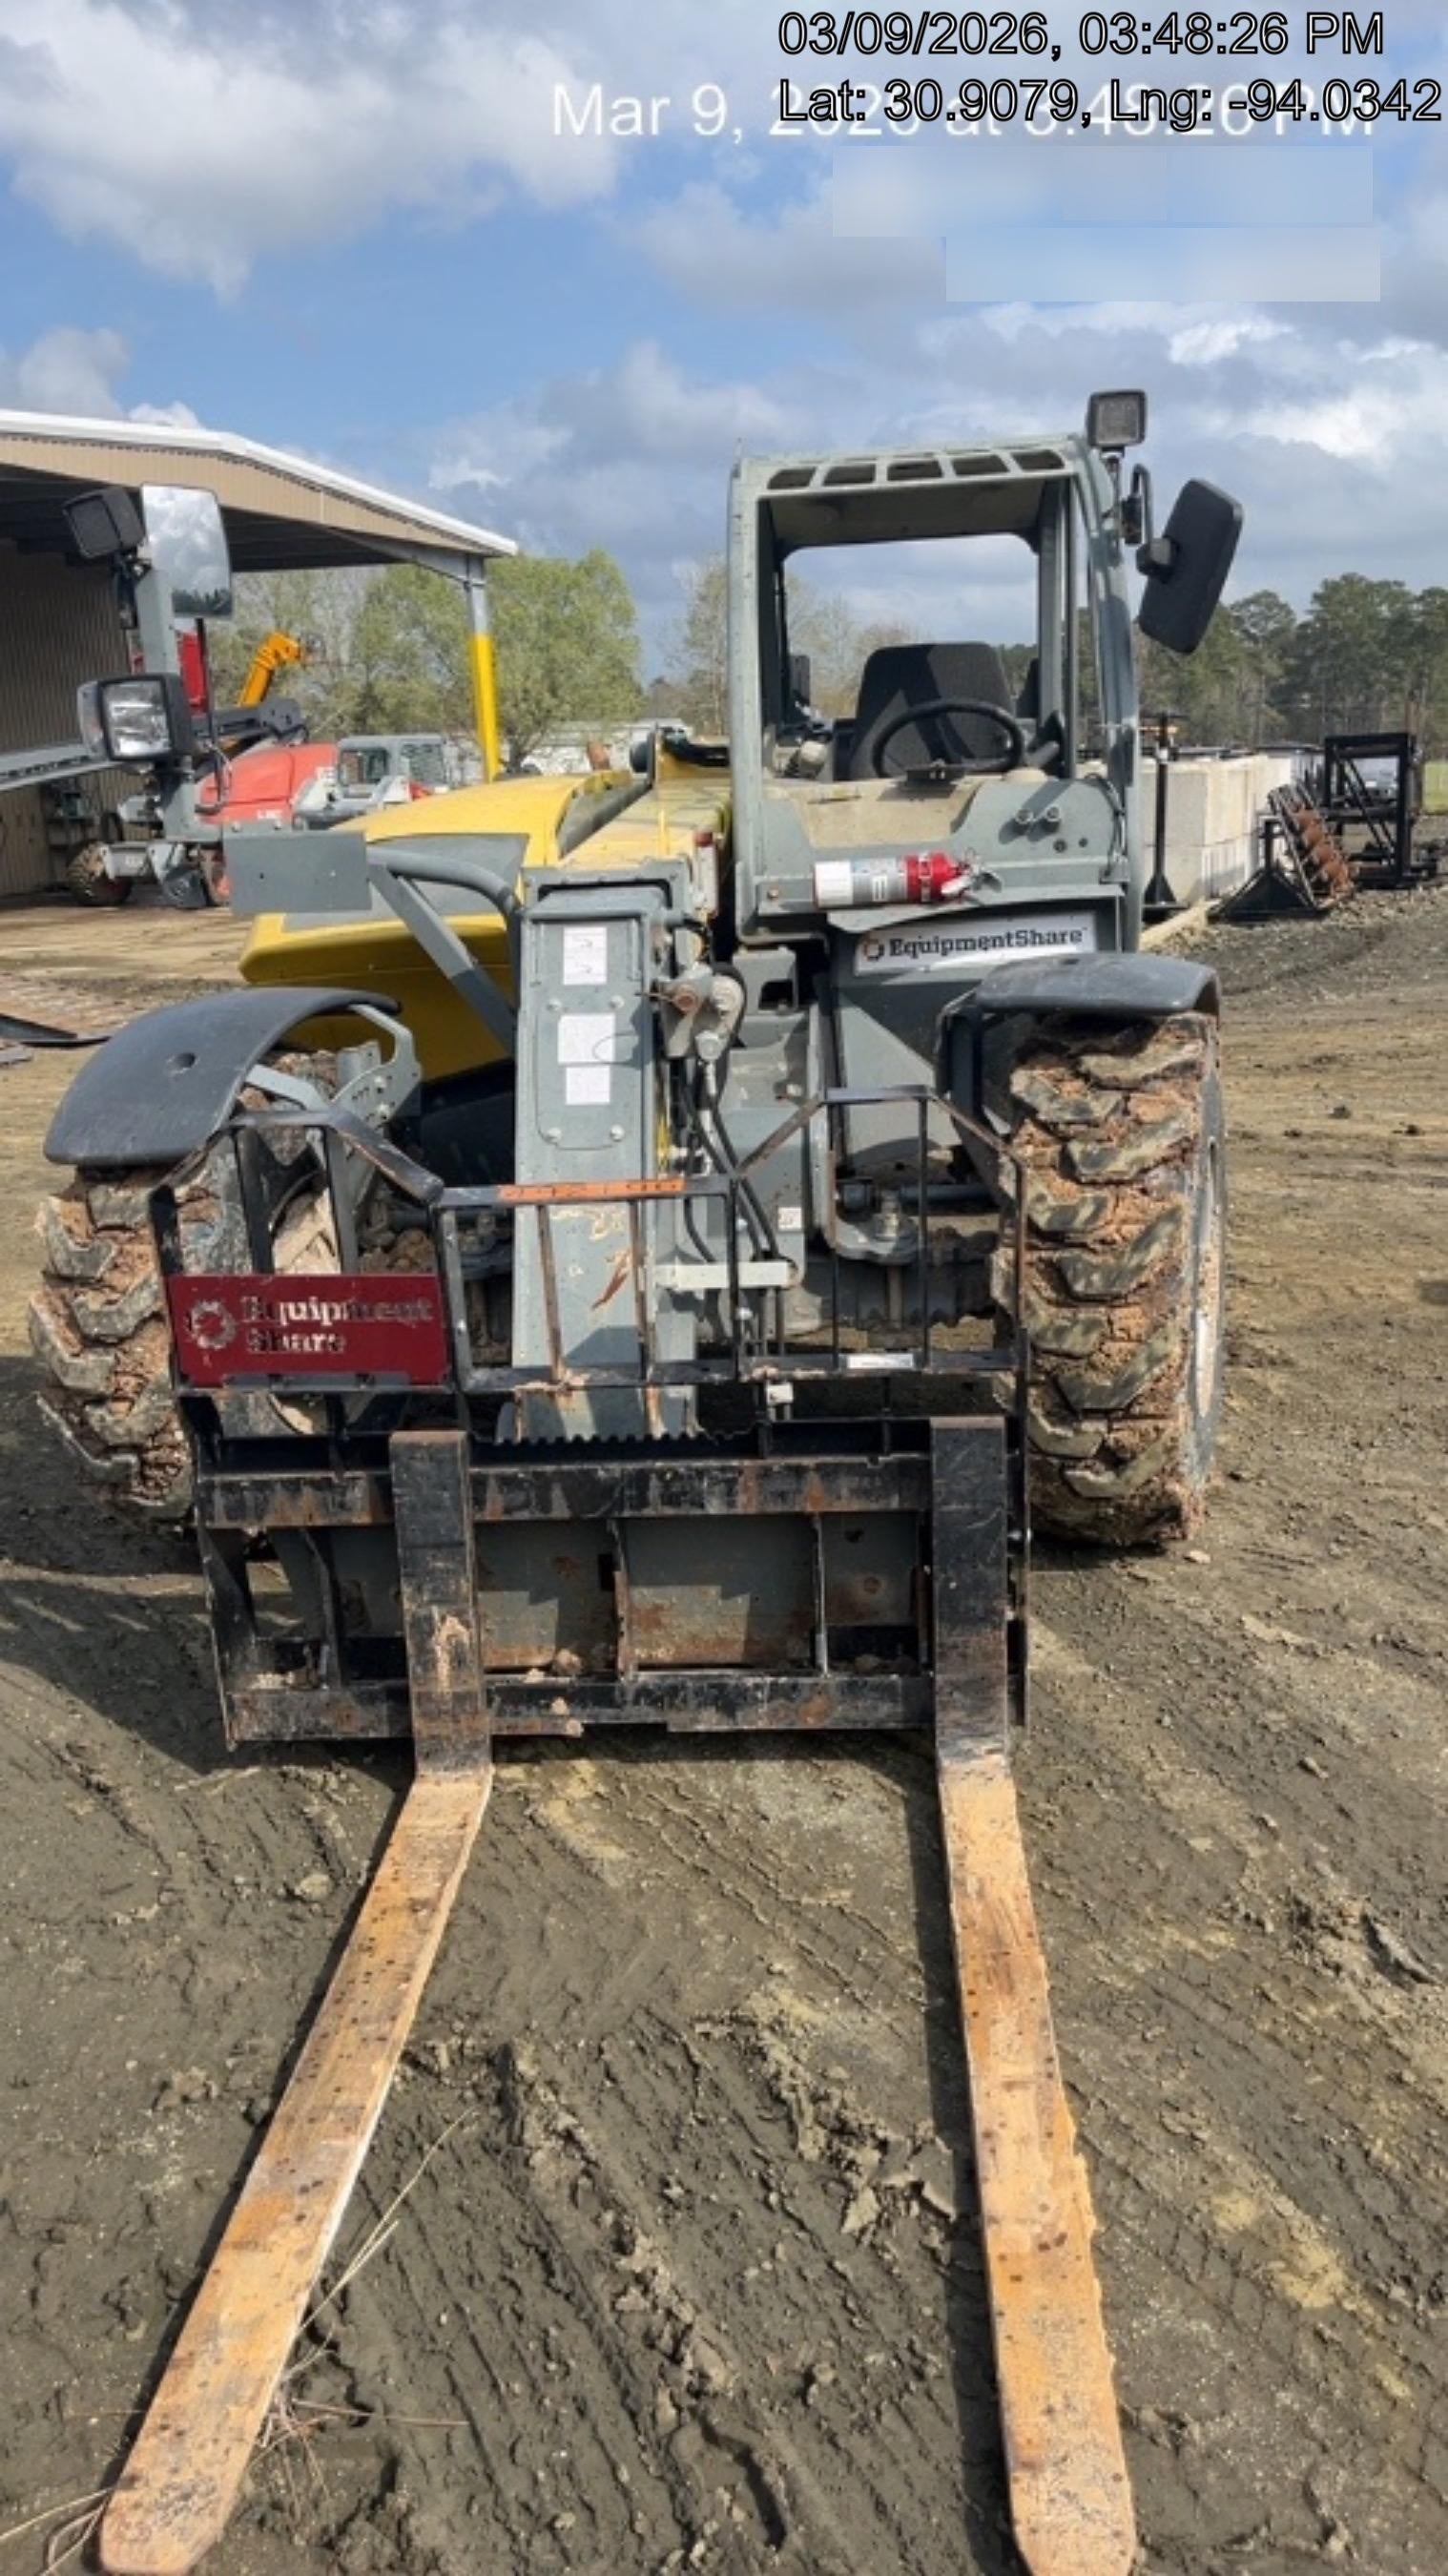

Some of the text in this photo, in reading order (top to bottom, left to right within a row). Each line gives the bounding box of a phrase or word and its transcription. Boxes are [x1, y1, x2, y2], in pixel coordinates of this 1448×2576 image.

[889, 928, 1085, 960] EquipmentShare
[239, 1296, 433, 1327] Equipment
[245, 1328, 348, 1355] Share
